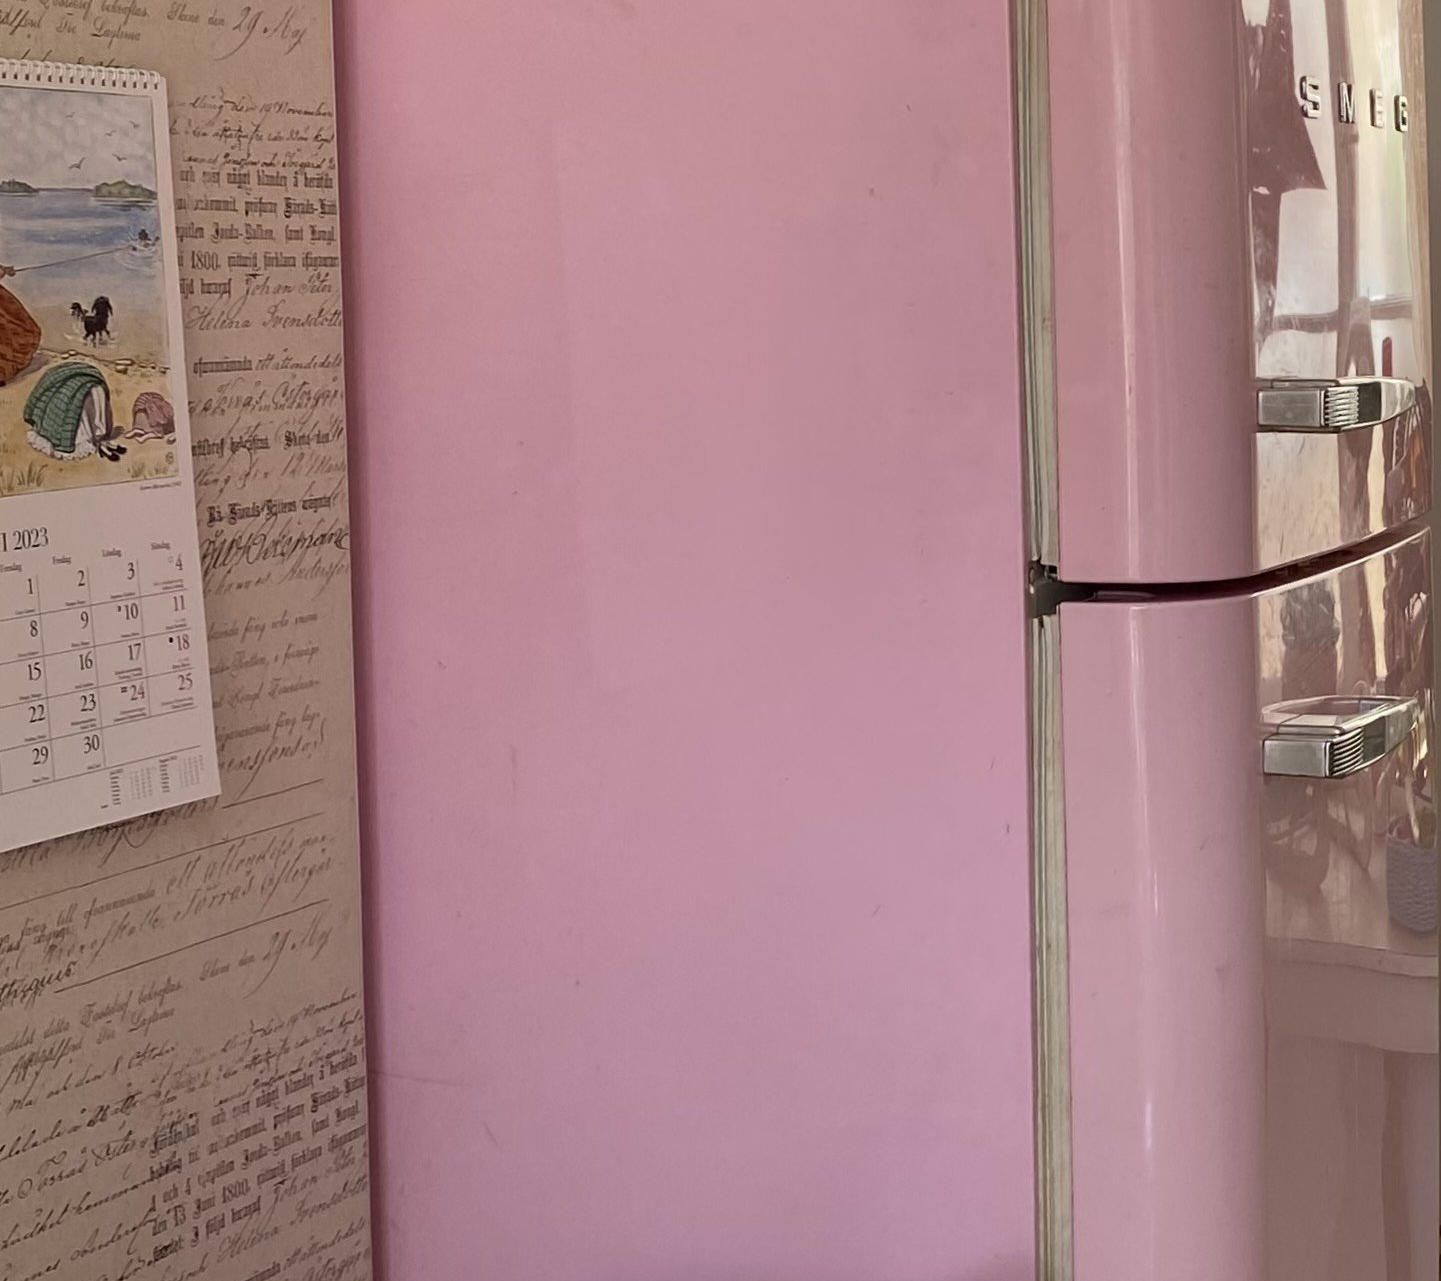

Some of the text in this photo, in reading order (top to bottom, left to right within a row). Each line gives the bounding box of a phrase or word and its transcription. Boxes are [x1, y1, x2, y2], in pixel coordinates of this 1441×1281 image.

[13, 527, 48, 550] 2023
[27, 553, 183, 595] 1 2 3 4
[30, 595, 185, 637] 8 9 10 11
[27, 634, 190, 681] 15 16 17 18
[28, 673, 193, 724] 22 23 24 25
[32, 734, 100, 765] 29 30
